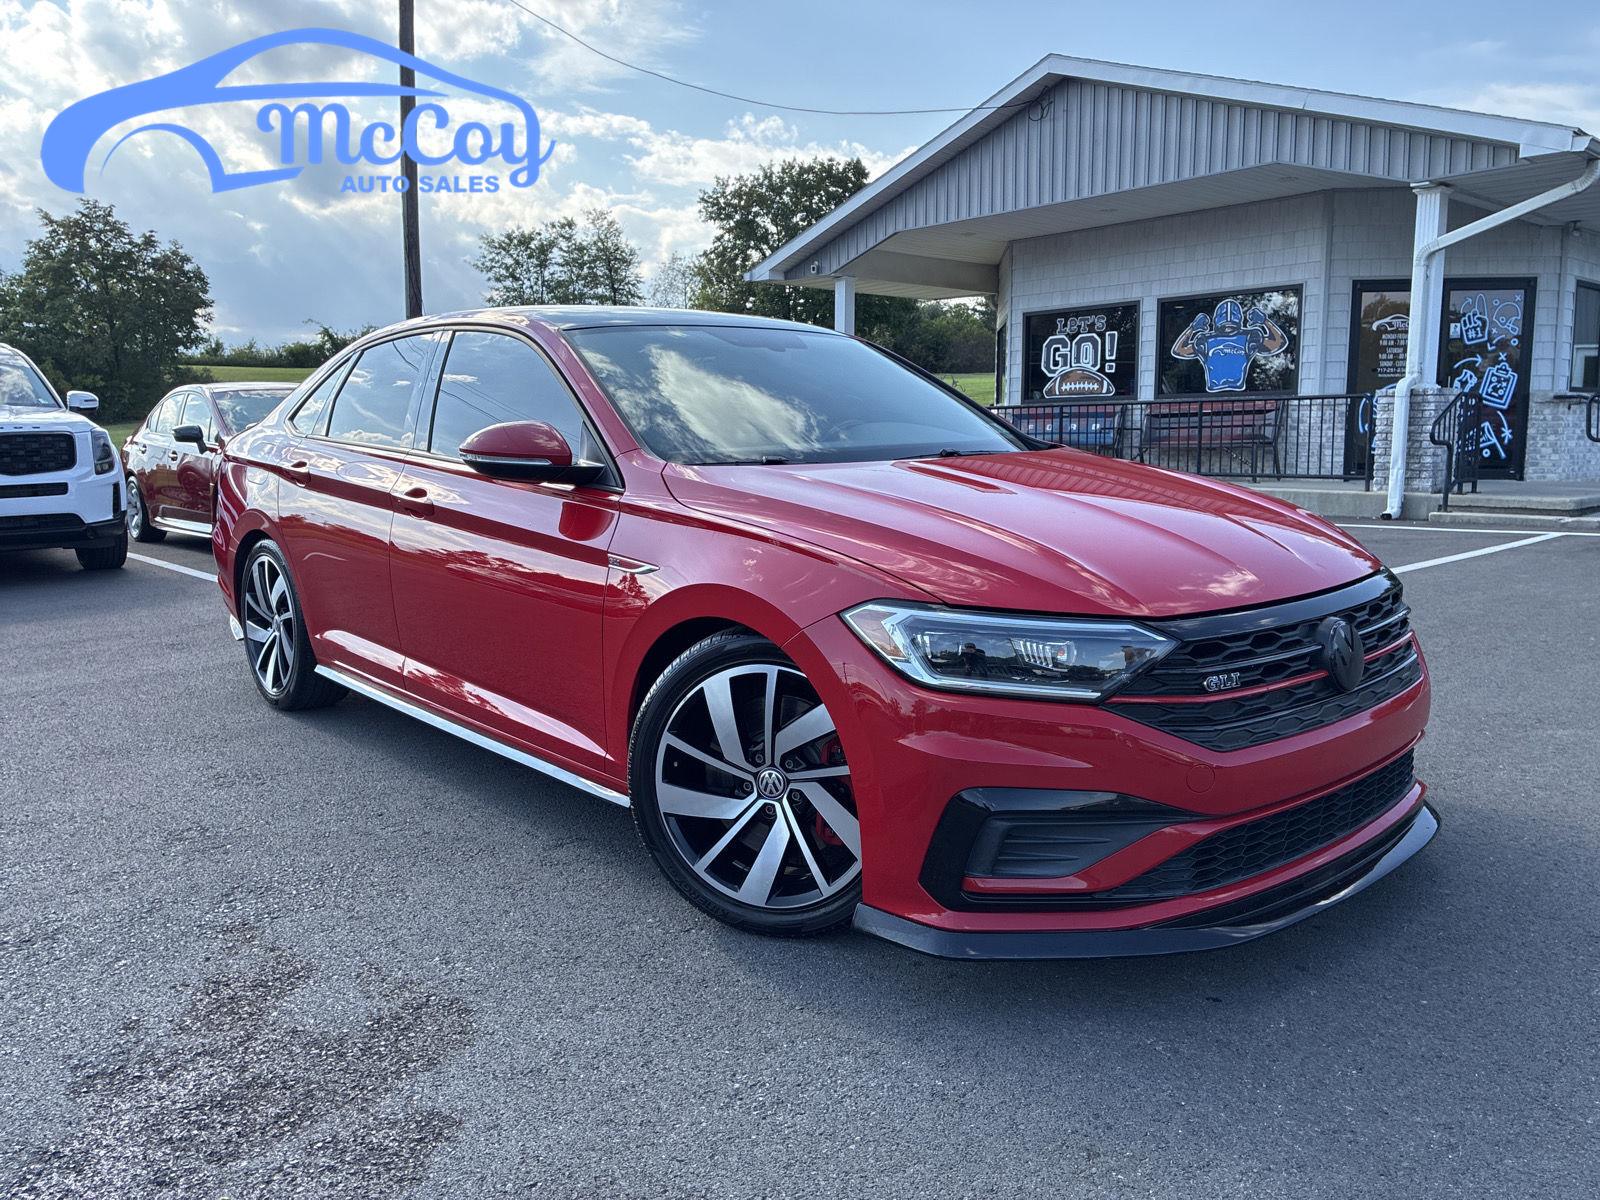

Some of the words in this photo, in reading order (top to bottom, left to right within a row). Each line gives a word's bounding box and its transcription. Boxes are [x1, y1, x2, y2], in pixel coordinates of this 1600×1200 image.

[1467, 327, 1483, 339] #1
[1041, 331, 1118, 377] GO!
[1203, 672, 1241, 692] GLI
